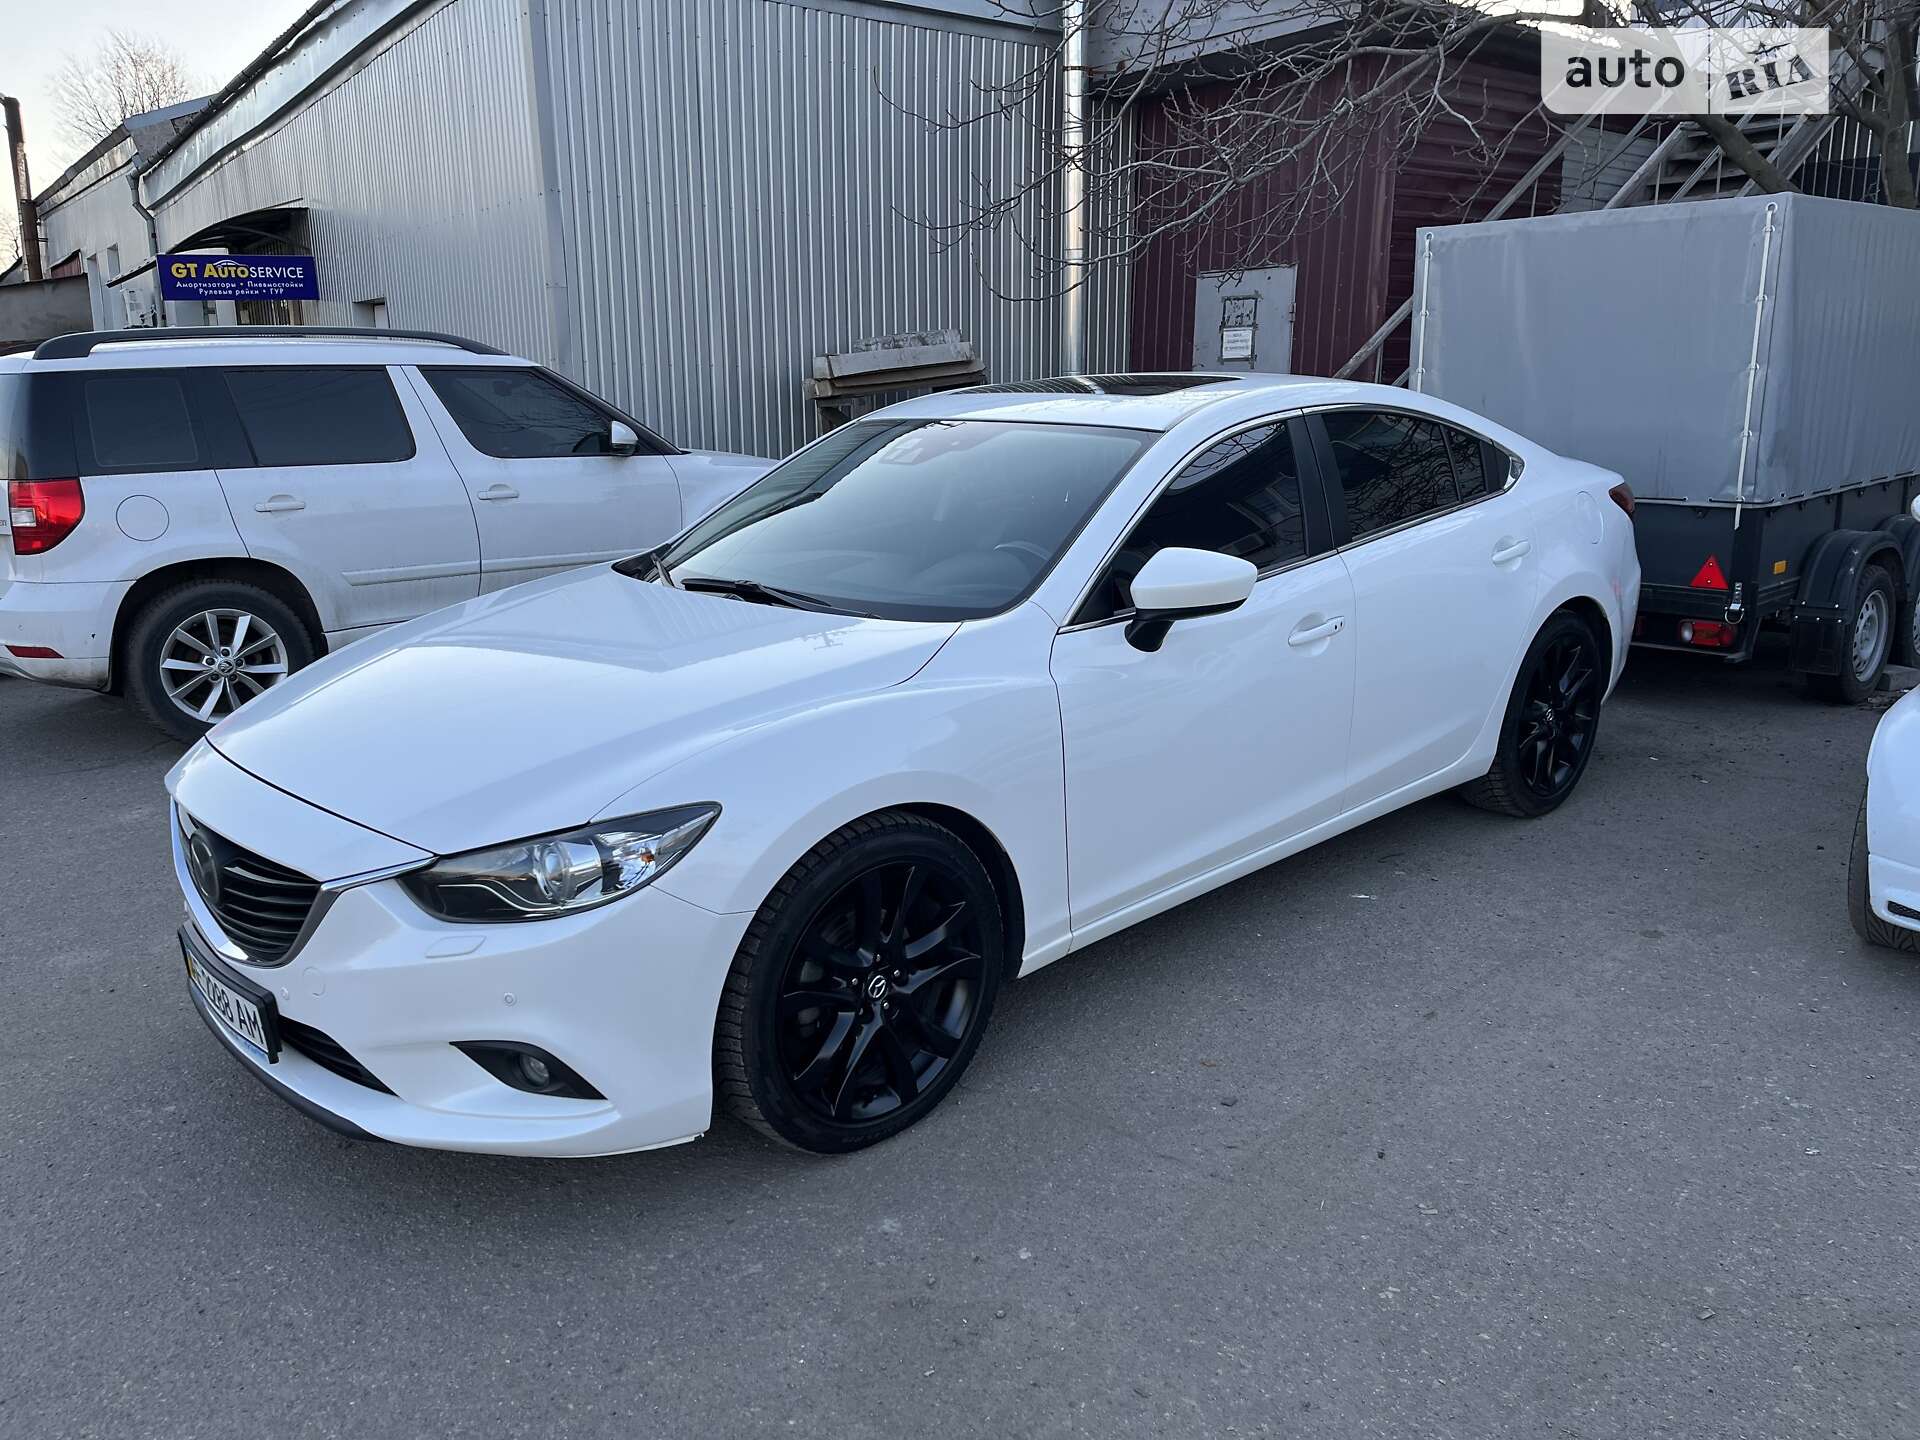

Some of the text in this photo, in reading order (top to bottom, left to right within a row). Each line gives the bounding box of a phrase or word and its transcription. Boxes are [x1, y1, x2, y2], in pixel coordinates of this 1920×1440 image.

[171, 263, 197, 279] GT
[176, 280, 304, 289] Амортизаторы Пневмостойки
[199, 288, 233, 296] Рулевые
[235, 288, 259, 296] рейки
[235, 998, 264, 1045] AM
